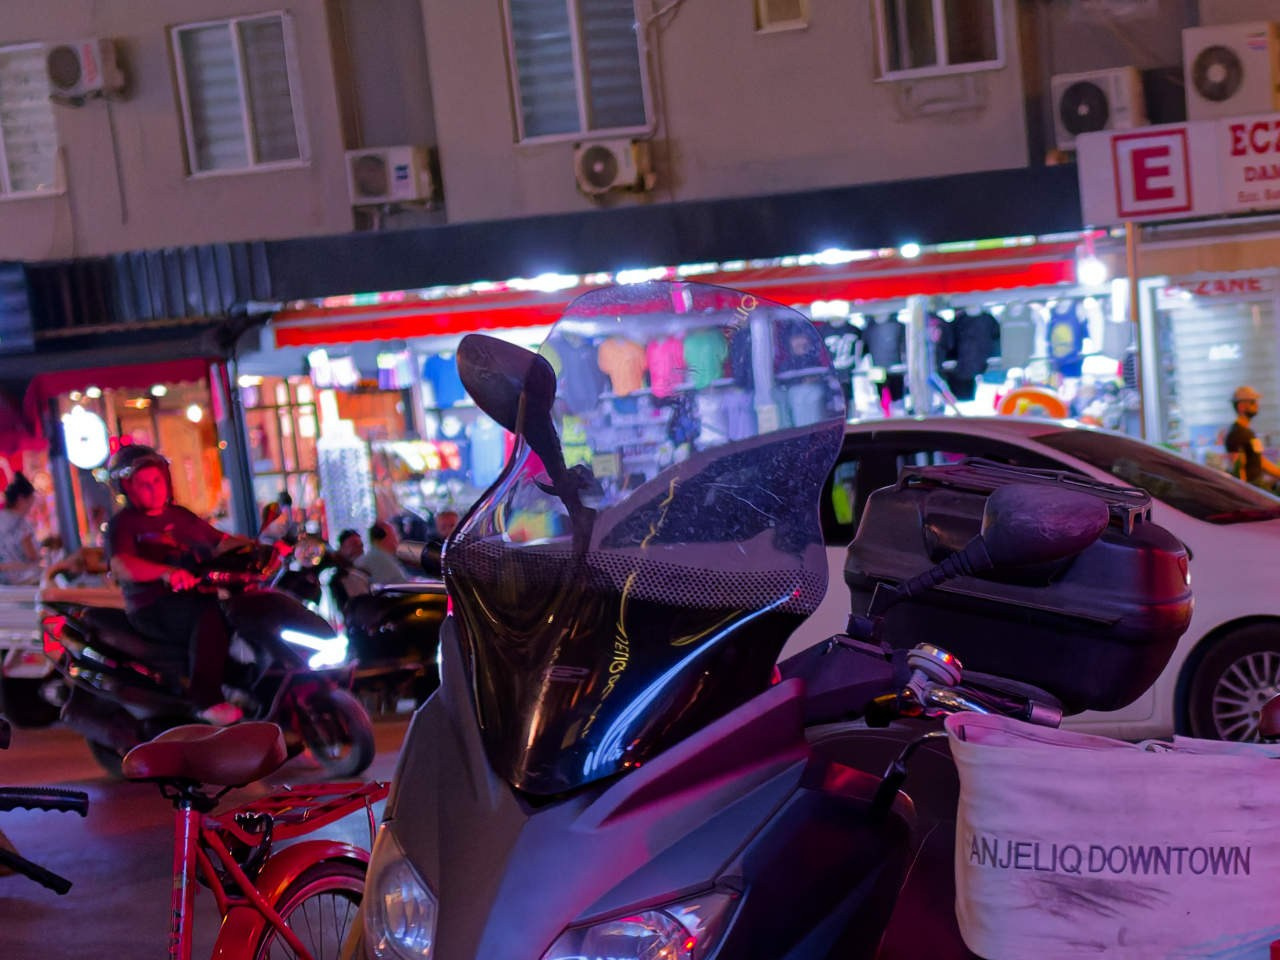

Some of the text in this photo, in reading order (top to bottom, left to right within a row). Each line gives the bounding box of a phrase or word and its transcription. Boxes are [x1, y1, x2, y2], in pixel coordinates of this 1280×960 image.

[1130, 145, 1176, 201] E
[969, 834, 1251, 875] ANJELIQ DOWNTOWN
